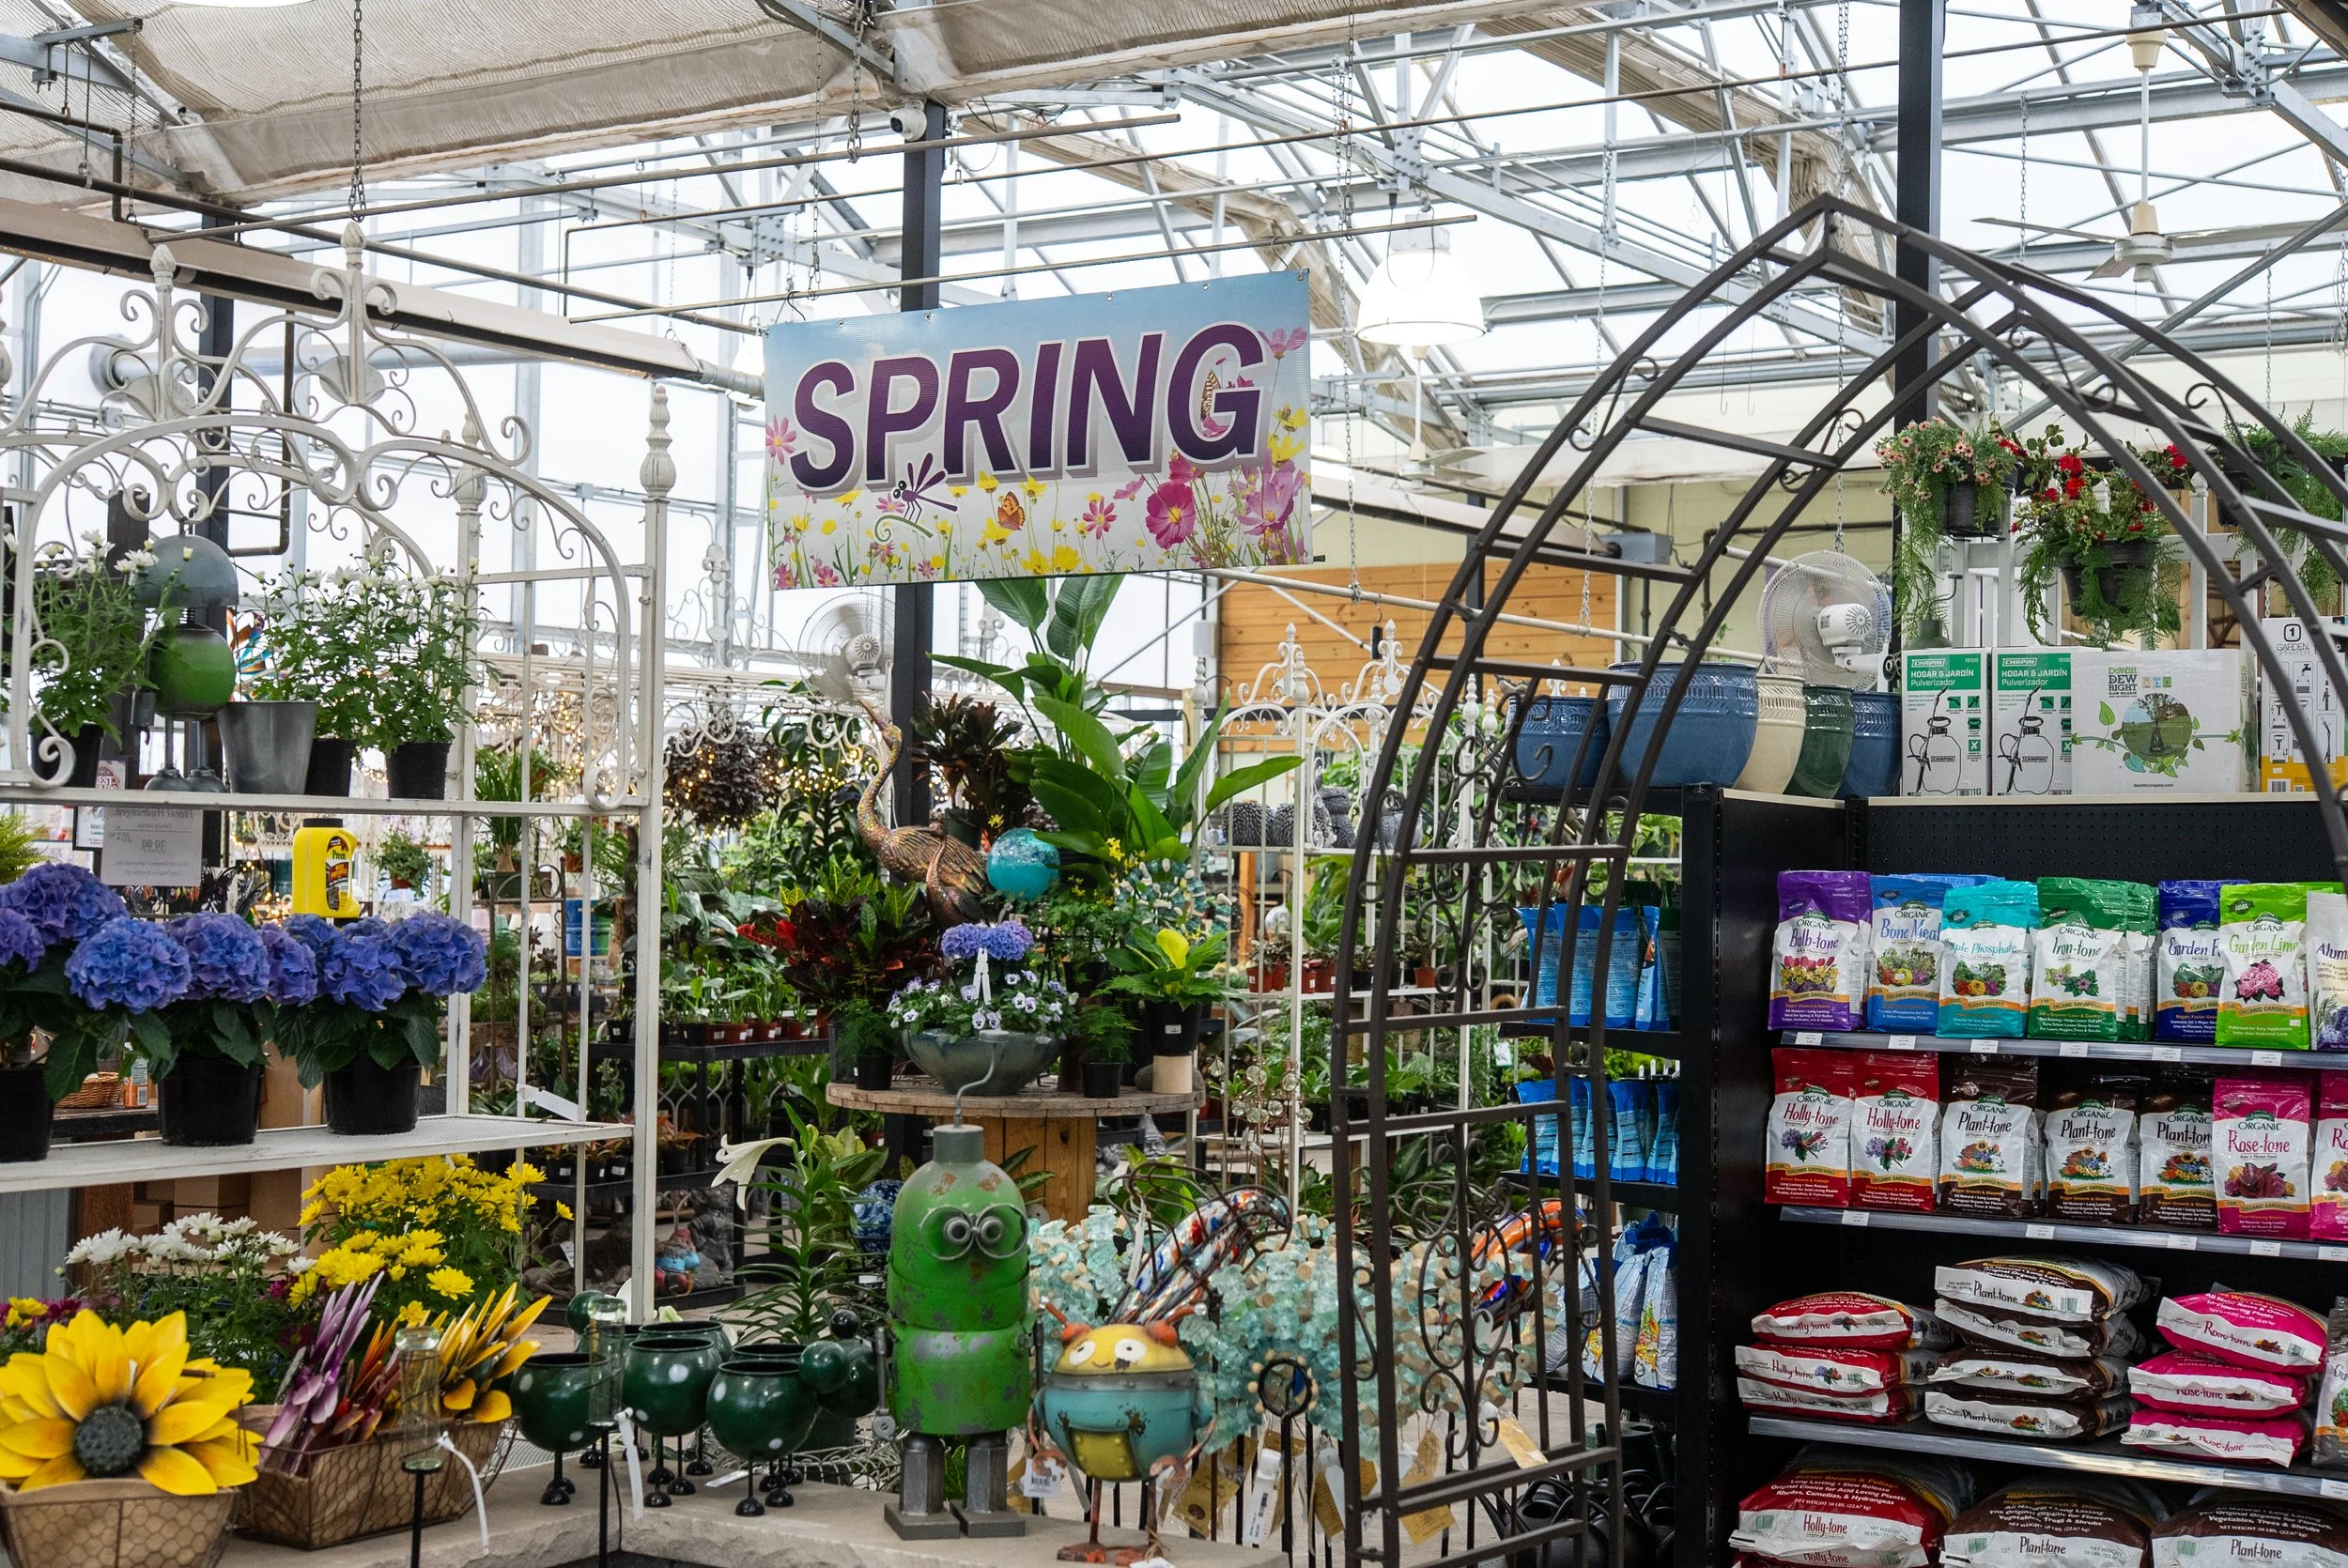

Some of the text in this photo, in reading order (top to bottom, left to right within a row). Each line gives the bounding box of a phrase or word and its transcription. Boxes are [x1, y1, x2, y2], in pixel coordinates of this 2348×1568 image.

[790, 322, 1267, 492] SPRING
[2289, 627, 2295, 638] 1
[2276, 643, 2309, 652] GARDEN
[1910, 669, 1938, 678] HOGAR
[1945, 668, 1974, 677] JARDÍN
[2001, 669, 2029, 678] HOGAR
[2037, 668, 2067, 677] JARDÍN
[2109, 667, 2138, 675] DeWitt
[1910, 678, 1955, 686] Pulverizador
[2001, 678, 2048, 686] Pulverizador
[2109, 675, 2138, 684] DEW
[332, 850, 346, 859] Preen
[1797, 919, 1837, 930] ORGANIC
[1880, 918, 1941, 941] Bone Meal
[2246, 923, 2289, 932] ORGANIC
[1789, 928, 1839, 949] Bulb-tone
[2059, 926, 2101, 940] ORGANIC
[1971, 941, 2017, 955] Phosphate
[2052, 937, 2102, 958] Iron-tone
[2168, 937, 2208, 956] Garden
[2230, 934, 2268, 954] Garden
[2271, 934, 2299, 952] Lime
[2238, 1007, 2263, 1015] ORGANIC
[1797, 1095, 1835, 1106] ORGANIC
[1878, 1099, 1916, 1108] ORGANIC
[1784, 1103, 1839, 1126] Holly-tone
[1970, 1104, 2011, 1115] ORGANIC
[2071, 1111, 2112, 1119] ORGANIC
[1866, 1107, 1921, 1134] Holly-tone
[1957, 1112, 2012, 1134] Plant-tone
[2167, 1115, 2212, 1125] ORGANIC
[2238, 1121, 2282, 1130] ORGANIC
[2061, 1119, 2116, 1139] Plant-tone
[2156, 1121, 2213, 1144] Plant-ton
[2228, 1130, 2290, 1153] Rose-tone
[1973, 1280, 2018, 1303] Plant-tone
[2252, 1311, 2274, 1319] Plants
[1805, 1490, 1842, 1499] Camellias,
[1851, 1495, 1894, 1505] Hydrangeas
[1856, 1489, 1879, 1498] Loving
[2291, 1513, 2322, 1523] Lasting
[1803, 1514, 1847, 1538] Holly-tone
[2208, 1515, 2254, 1524] Vegetables,
[2291, 1524, 2321, 1533] Shrubs
[2020, 1536, 2066, 1555] Plant-tone
[2231, 1539, 2282, 1560] Plant-tone
